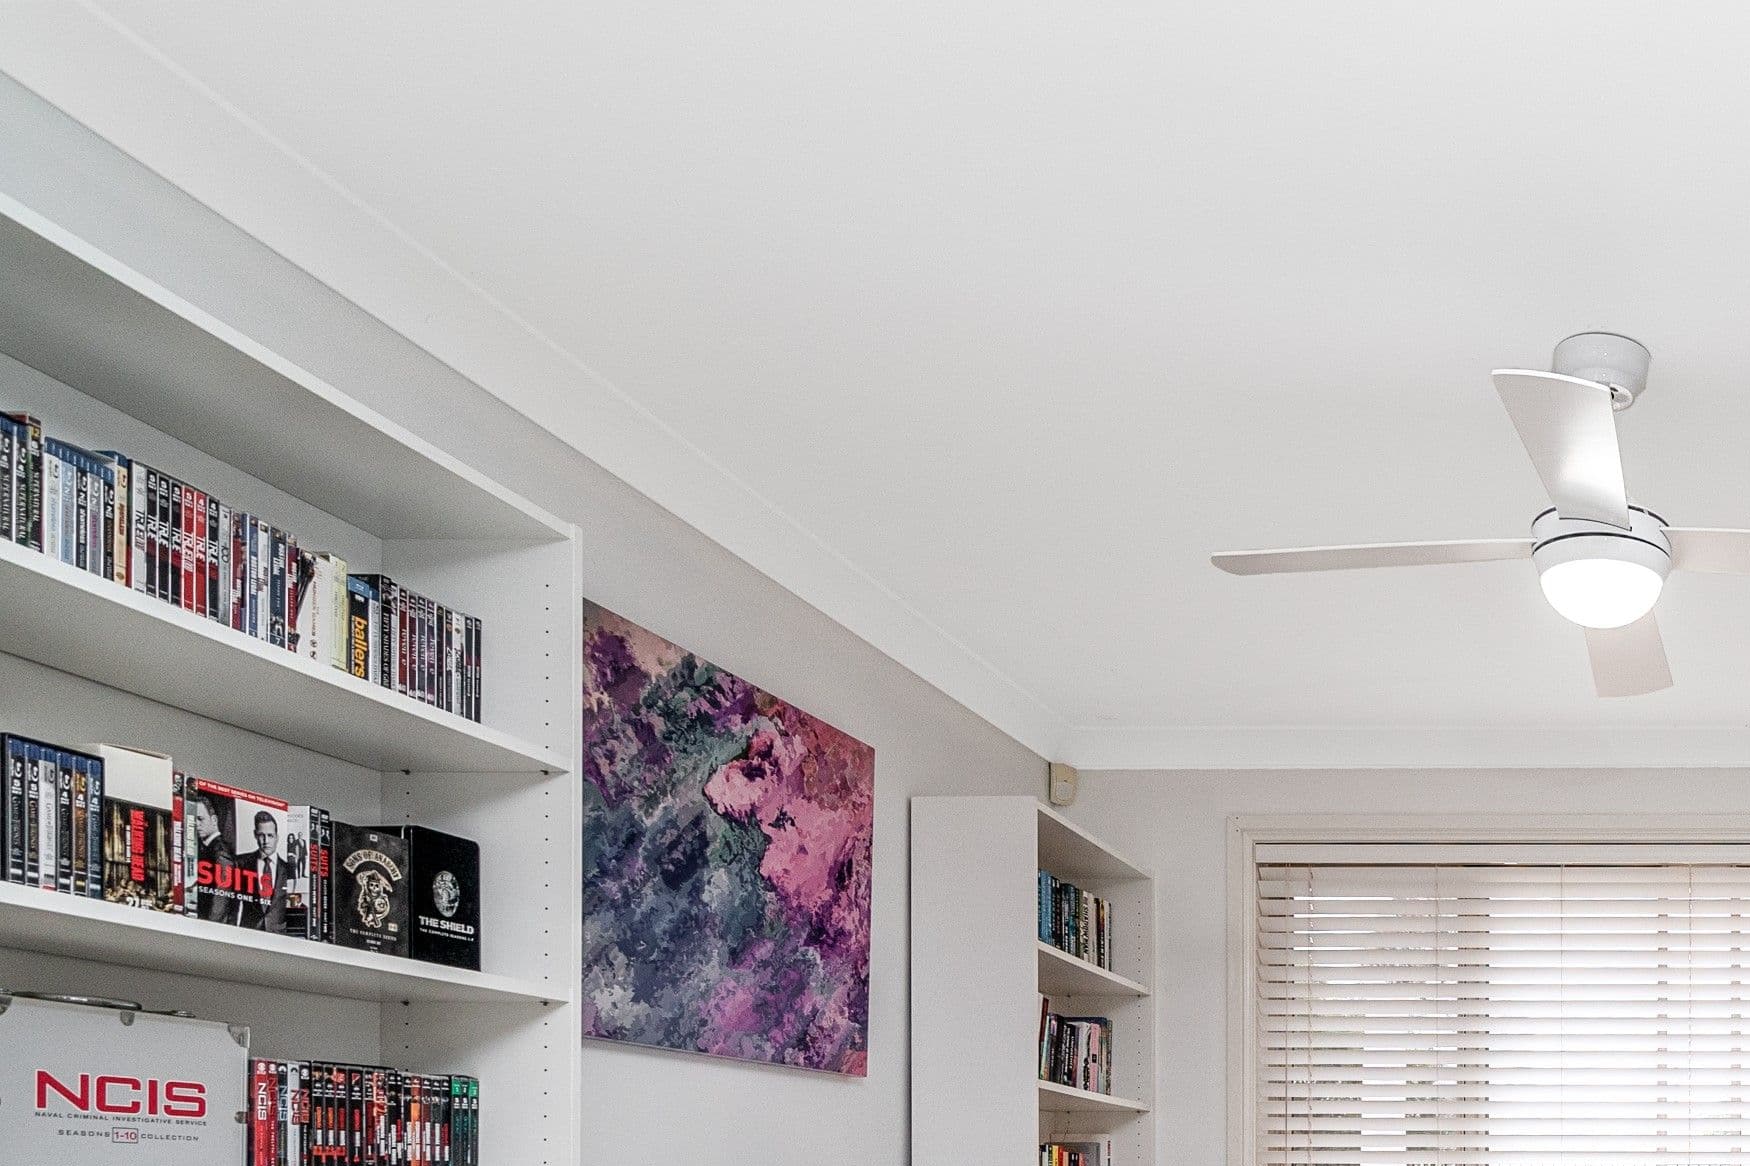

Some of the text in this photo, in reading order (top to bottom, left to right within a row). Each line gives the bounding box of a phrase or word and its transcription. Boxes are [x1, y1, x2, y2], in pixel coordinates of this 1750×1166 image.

[355, 616, 367, 678] ballers
[132, 810, 144, 881] WALKING DEAD
[198, 860, 274, 899] SUITS
[199, 886, 235, 899] SEASONS
[237, 892, 253, 902] ONE
[419, 916, 474, 935] THE SHIELD
[35, 1069, 207, 1118] NCIS
[58, 1129, 199, 1142] SEASONS 1-10 COLLECTION
